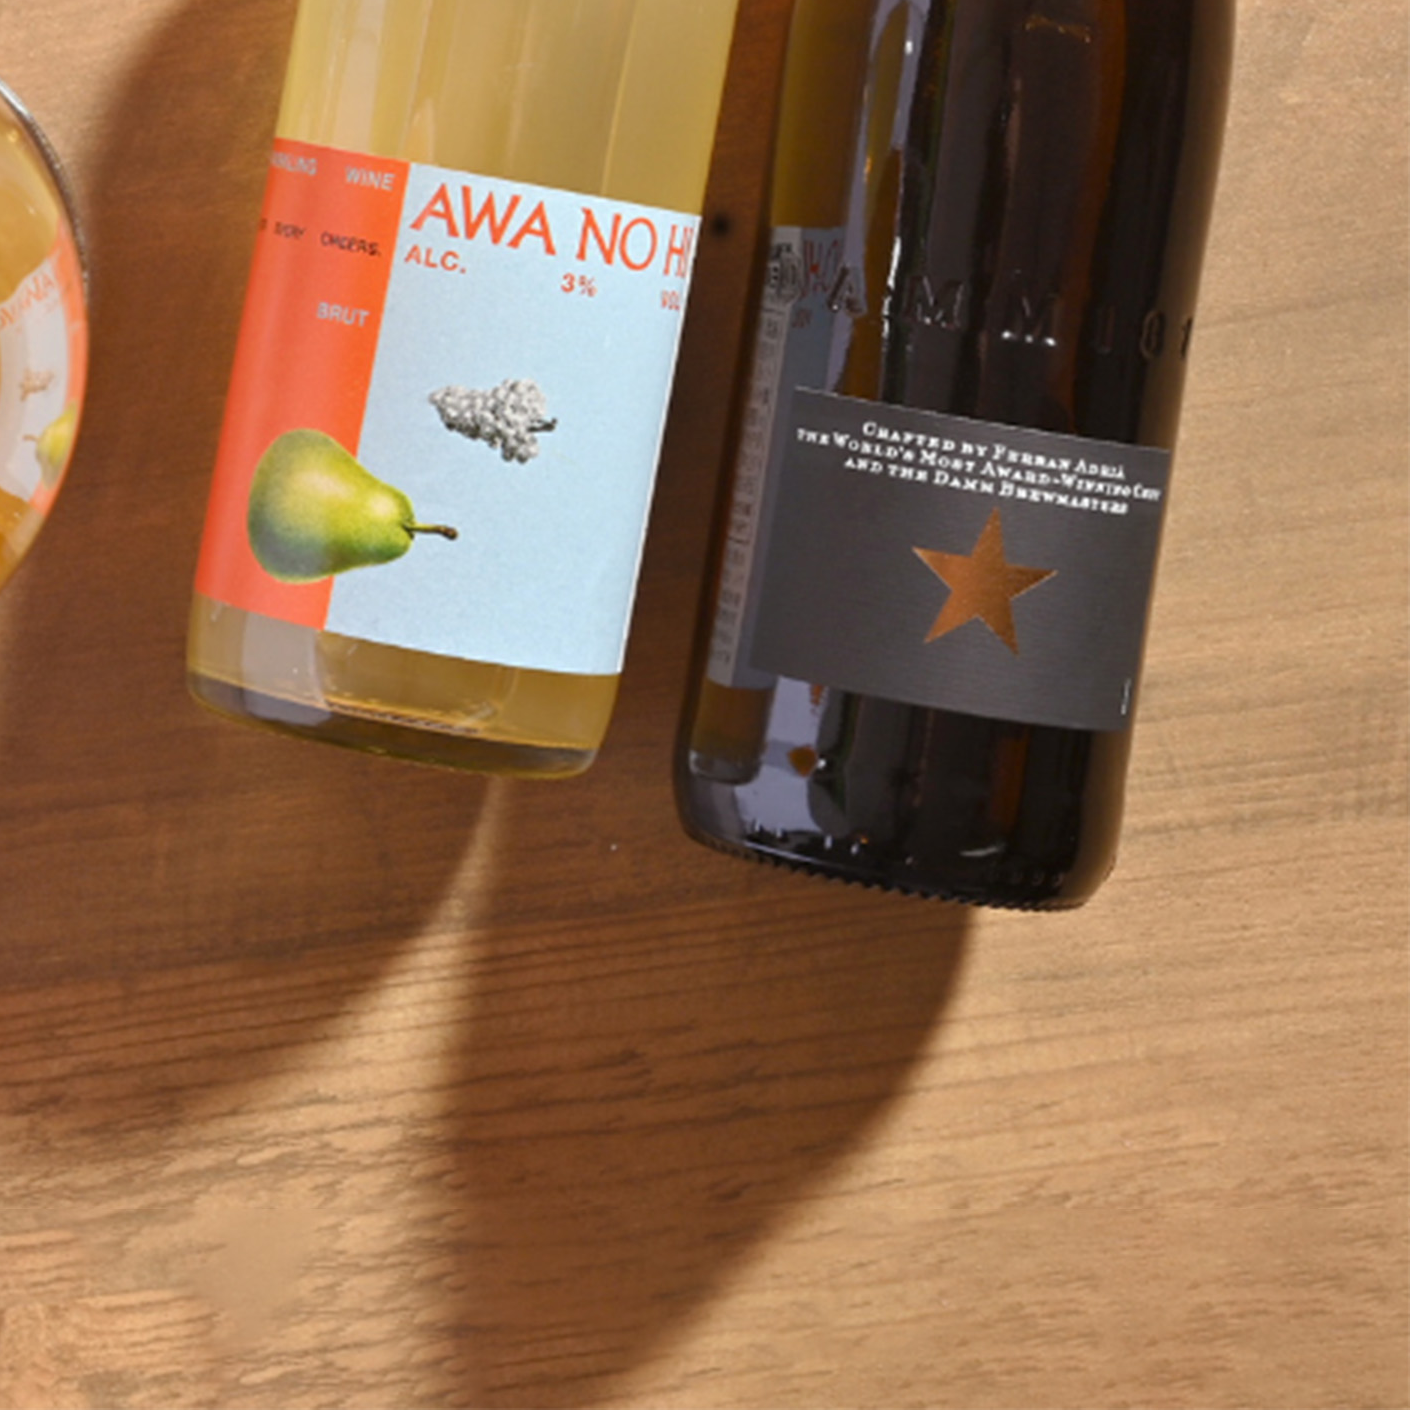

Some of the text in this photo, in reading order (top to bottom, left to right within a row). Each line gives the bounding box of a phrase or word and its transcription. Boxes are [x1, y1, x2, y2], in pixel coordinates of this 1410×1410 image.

[344, 165, 396, 191] WINE
[409, 182, 557, 257] AWA
[576, 205, 658, 272] NO
[404, 243, 467, 275] ALC.
[316, 301, 370, 328] BRUT
[796, 427, 830, 446] THE
[919, 448, 977, 472] MOST
[861, 420, 956, 452] CRAFTED
[960, 441, 988, 457] BY
[992, 443, 1072, 471] FERRAN
[844, 457, 884, 475] AND
[887, 463, 929, 483] THE
[932, 469, 994, 494] DAMM
